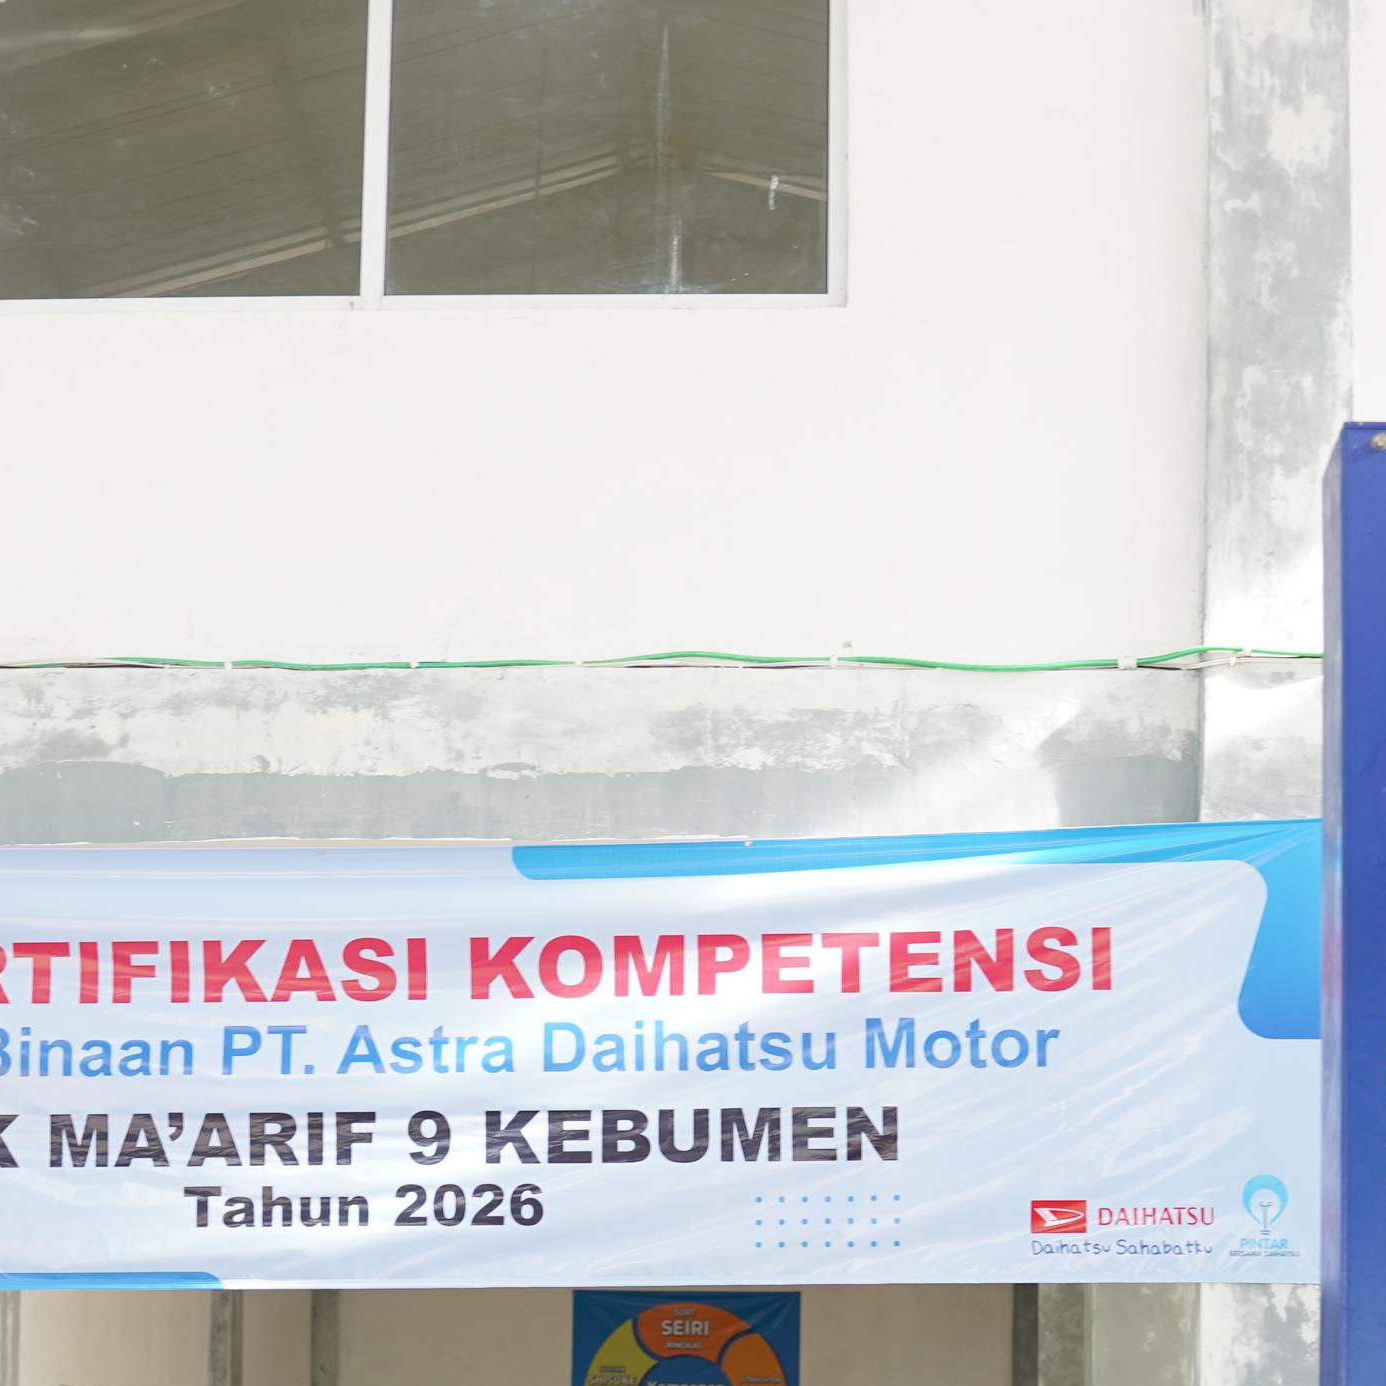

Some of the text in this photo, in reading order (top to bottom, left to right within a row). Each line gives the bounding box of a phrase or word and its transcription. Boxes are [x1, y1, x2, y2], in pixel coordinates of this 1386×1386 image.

[468, 925, 1113, 1001] KOMPETENSI
[220, 1024, 316, 1076] PT.
[336, 1023, 516, 1076] Astra
[541, 1018, 839, 1074] Daihatsu
[862, 1016, 1062, 1071] Motor
[49, 1111, 376, 1168] MA'ARIF
[408, 1110, 451, 1167] 9
[485, 1106, 899, 1165] KEBUMEN
[183, 1183, 545, 1229] Tahun 2026
[1098, 1206, 1215, 1227] DAIHATSU
[1030, 1239, 1214, 1256] Daihatsu Sahabatku
[660, 1320, 710, 1337] SEIRI
